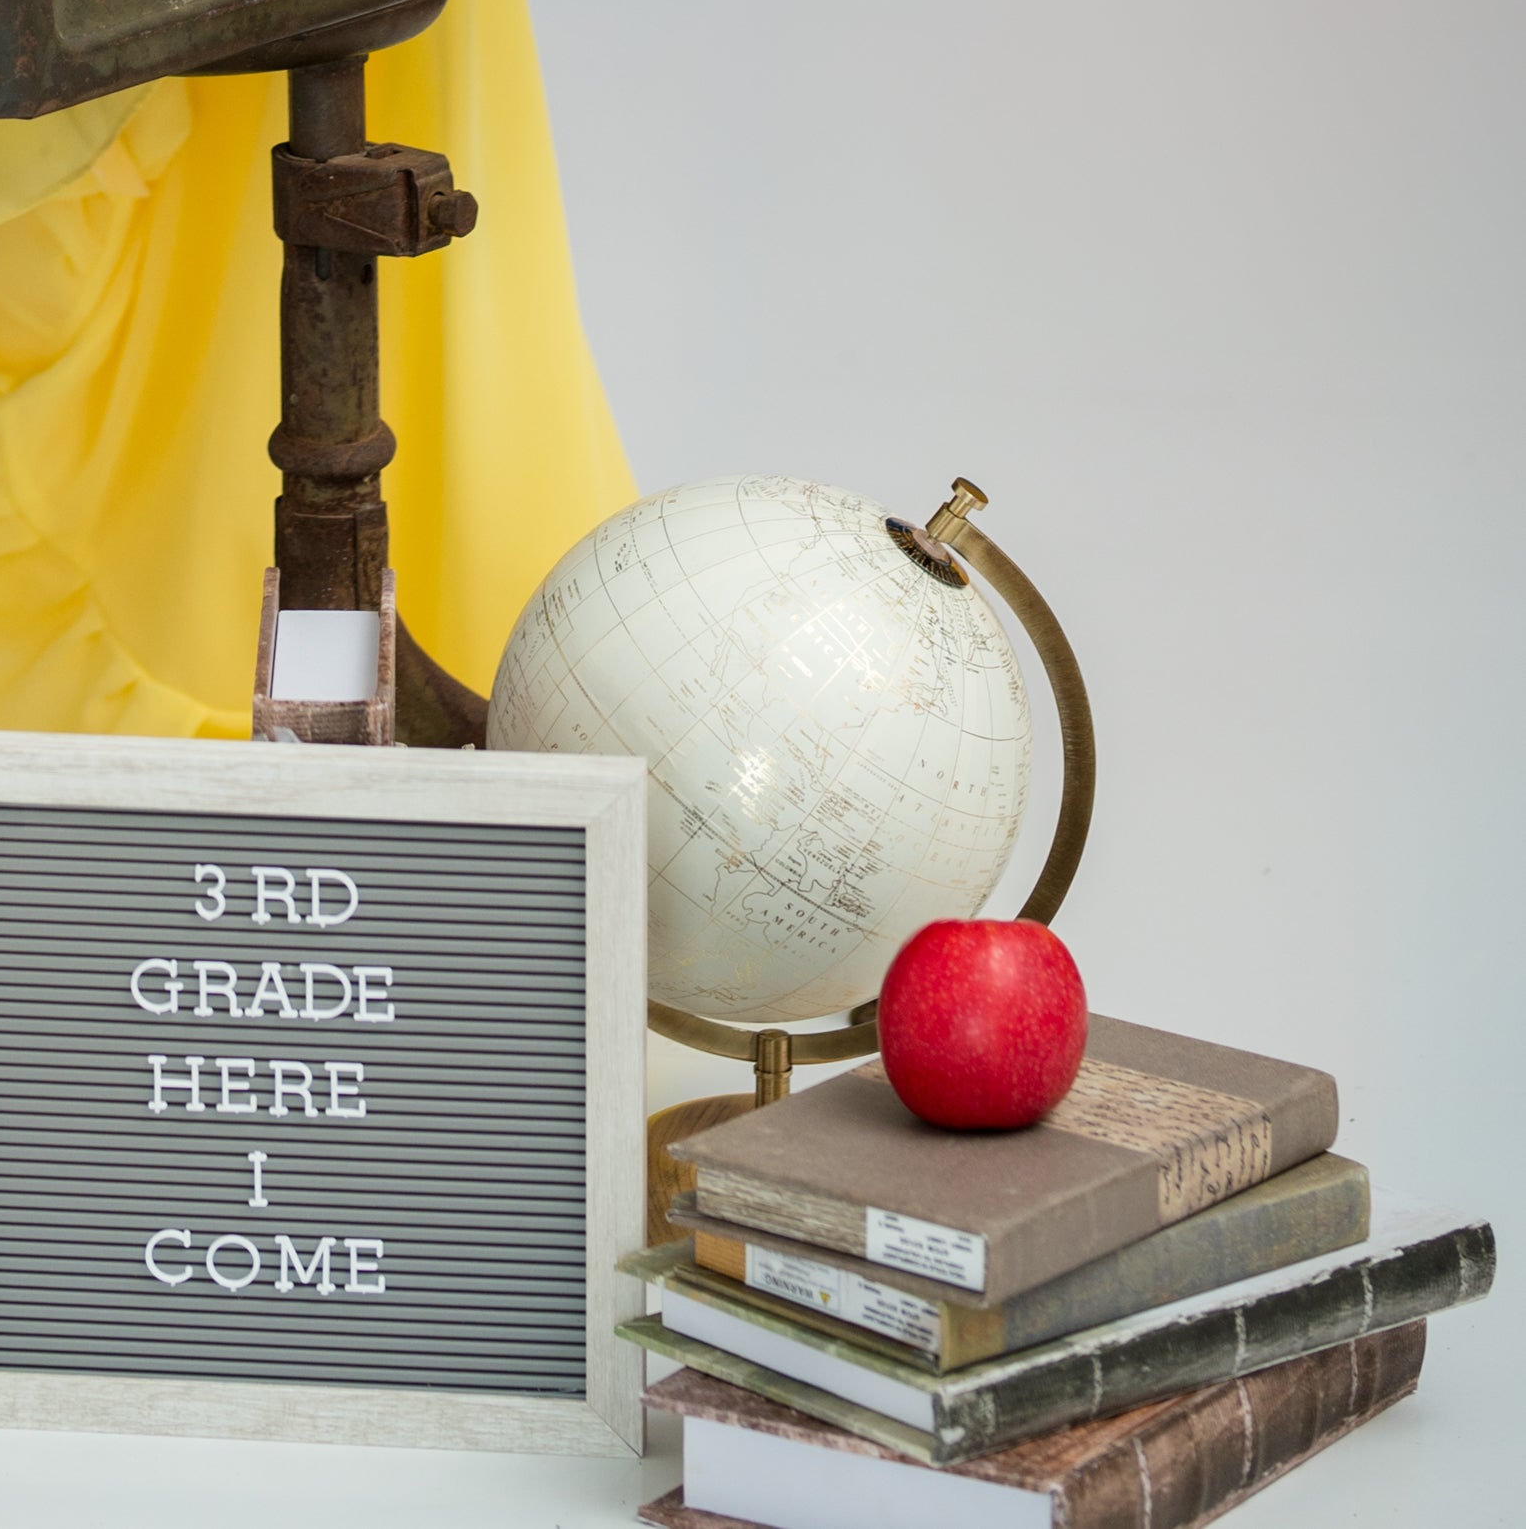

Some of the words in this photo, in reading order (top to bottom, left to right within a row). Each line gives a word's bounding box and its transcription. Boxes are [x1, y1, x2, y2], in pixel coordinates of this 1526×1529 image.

[571, 723, 603, 755] SOU
[760, 909, 837, 954] AMERICA
[784, 902, 840, 937] SOUTH
[130, 957, 395, 1023] GRADE
[147, 1054, 367, 1119] HERE
[247, 1150, 269, 1209] I
[144, 1228, 387, 1296] COME
[763, 1273, 814, 1300] WARNING
